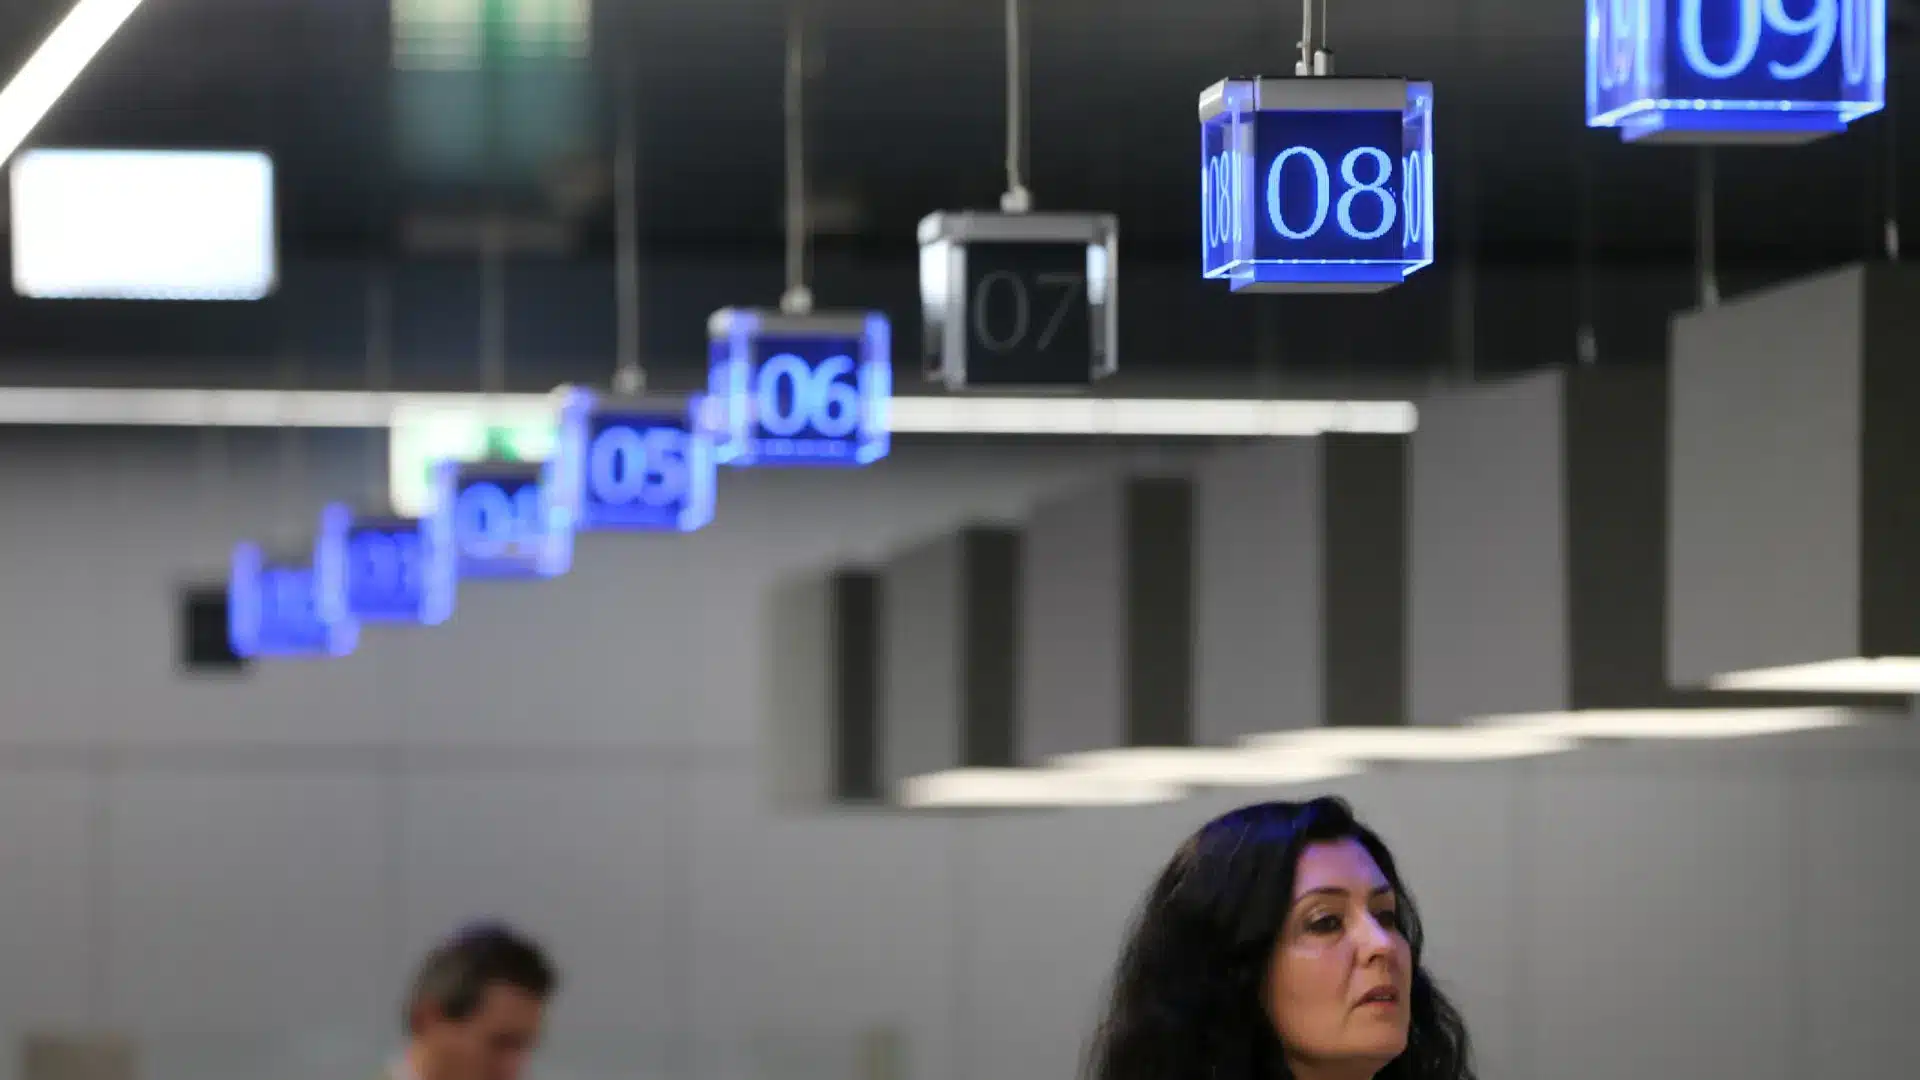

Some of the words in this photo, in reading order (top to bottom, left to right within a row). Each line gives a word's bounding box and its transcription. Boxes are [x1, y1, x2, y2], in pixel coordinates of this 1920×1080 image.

[1679, 0, 1838, 79] 09
[1266, 145, 1396, 240] 08
[973, 270, 1083, 352] 07
[756, 353, 859, 438] 06
[591, 425, 688, 506] 05
